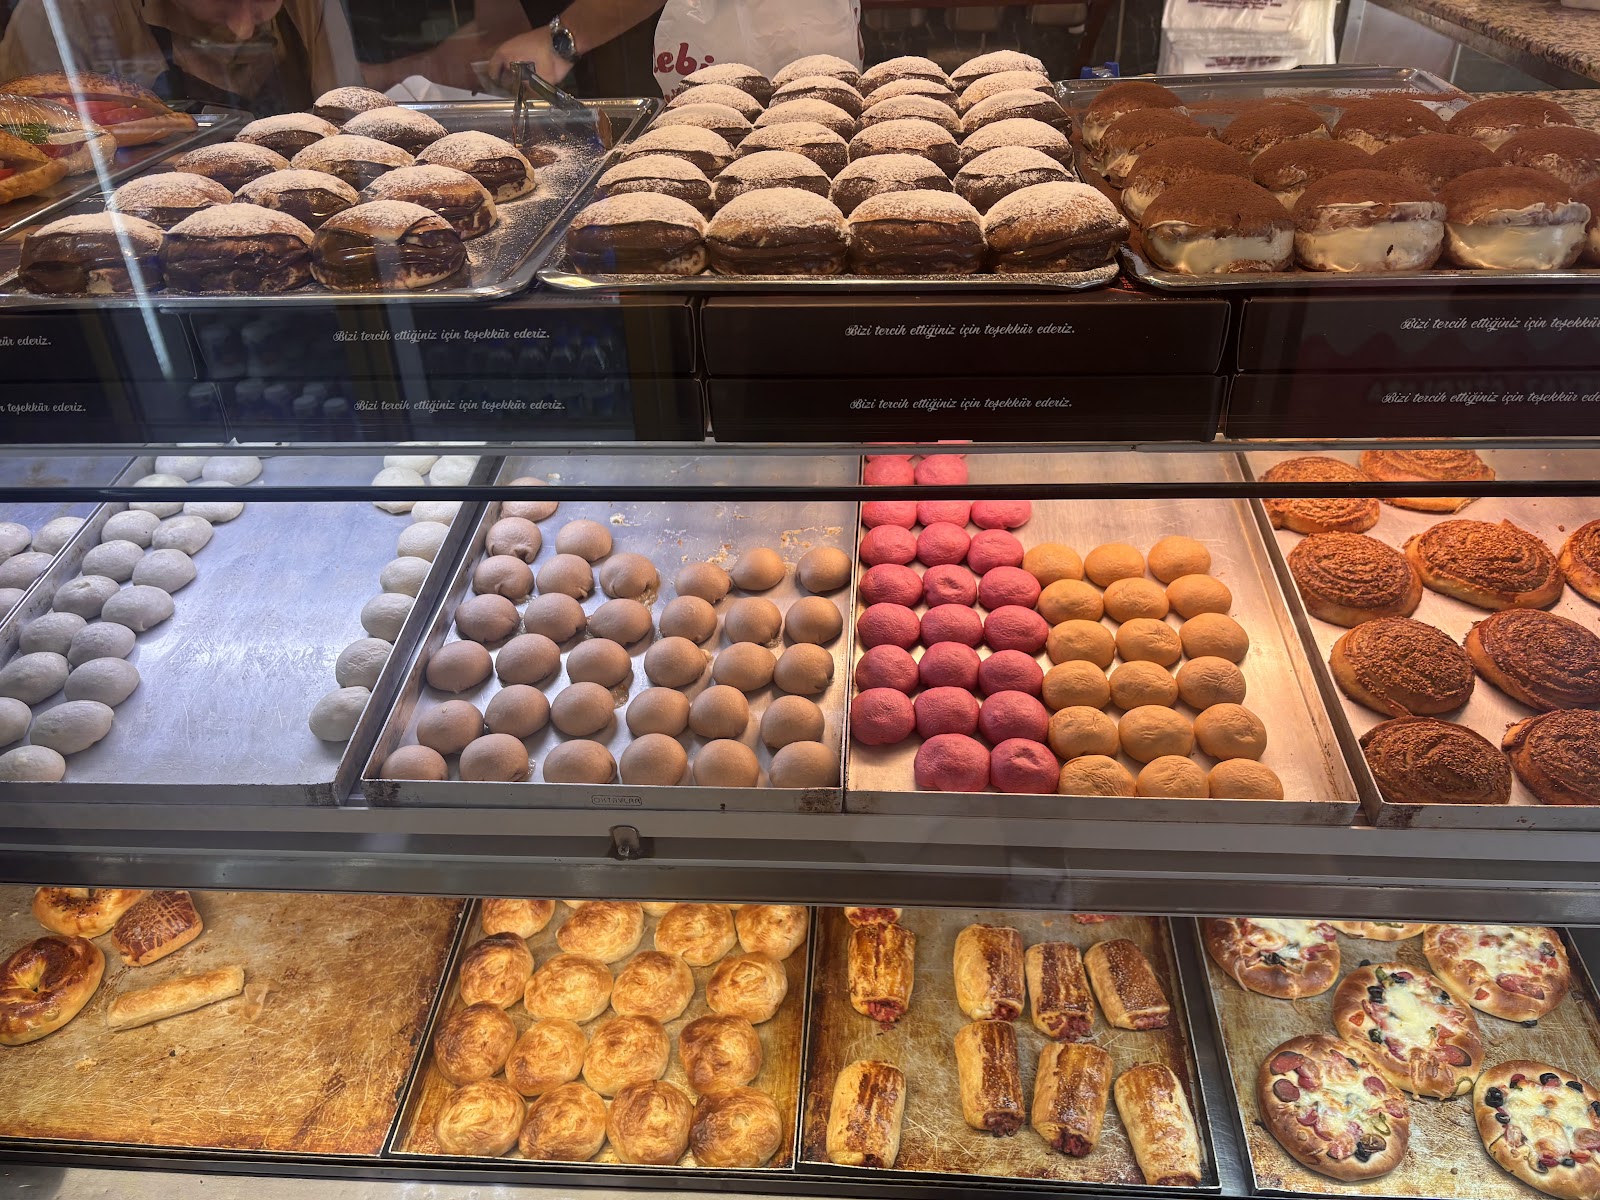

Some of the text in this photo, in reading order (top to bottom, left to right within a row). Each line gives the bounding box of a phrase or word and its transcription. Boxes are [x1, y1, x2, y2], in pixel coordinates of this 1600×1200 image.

[845, 323, 1075, 339] Bizi tercih ettiğiniz için teşekkür ederiz.
[1400, 318, 1431, 329] Bizi
[1433, 318, 1467, 329] tercih
[1471, 317, 1521, 332] ettiğiniz
[1524, 317, 1547, 331] için
[17, 335, 52, 346] ederiz.
[333, 328, 550, 344] Bizi tercih ettiğiniz için teşekkür ederiz.
[354, 399, 565, 413] Bizi tercih ettiğiniz için teşekkür ederiz.
[850, 397, 1072, 412] Bizi tercih ettiğiniz için teşekkür ederiz.
[1382, 392, 1411, 403] Bizi
[1413, 392, 1447, 403] tercih
[1450, 391, 1499, 406] ettiğiniz
[1502, 392, 1524, 404] için
[1527, 392, 1578, 405] teşekkür
[7, 402, 50, 415] teşekkür
[52, 402, 87, 412] ederiz.
